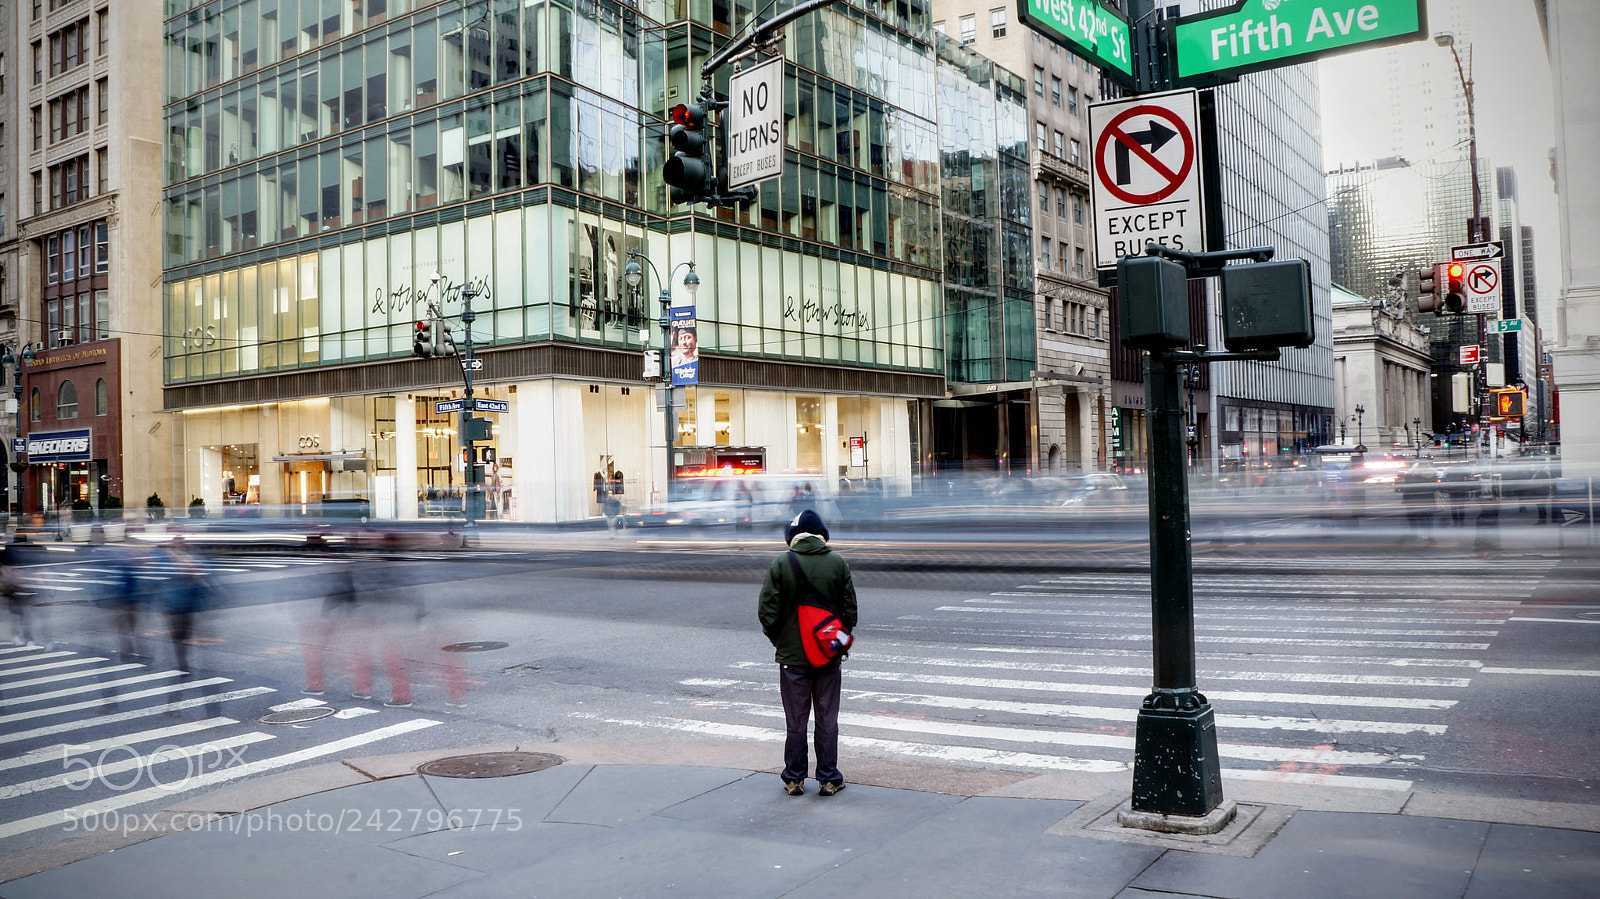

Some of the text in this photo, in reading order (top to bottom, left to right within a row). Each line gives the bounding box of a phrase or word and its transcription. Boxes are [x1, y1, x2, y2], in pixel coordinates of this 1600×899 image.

[1079, 5, 1107, 45] 42nd
[1111, 26, 1127, 63] St
[1211, 4, 1379, 61] Fifth Ave
[742, 81, 768, 118] NO
[732, 119, 779, 157] TURNS
[733, 154, 776, 179] EXCEPT BUSES
[1108, 209, 1187, 236] EXCEPT
[1458, 246, 1496, 257] ONE WAY
[372, 287, 386, 315] &
[784, 295, 796, 322] &
[1471, 295, 1496, 304] EXCEPT
[1500, 321, 1508, 331] 5
[439, 403, 452, 411] Fifth
[477, 401, 489, 409] East
[1111, 407, 1120, 436] ATM
[28, 437, 89, 456] SKECHERS
[298, 434, 320, 449] COS
